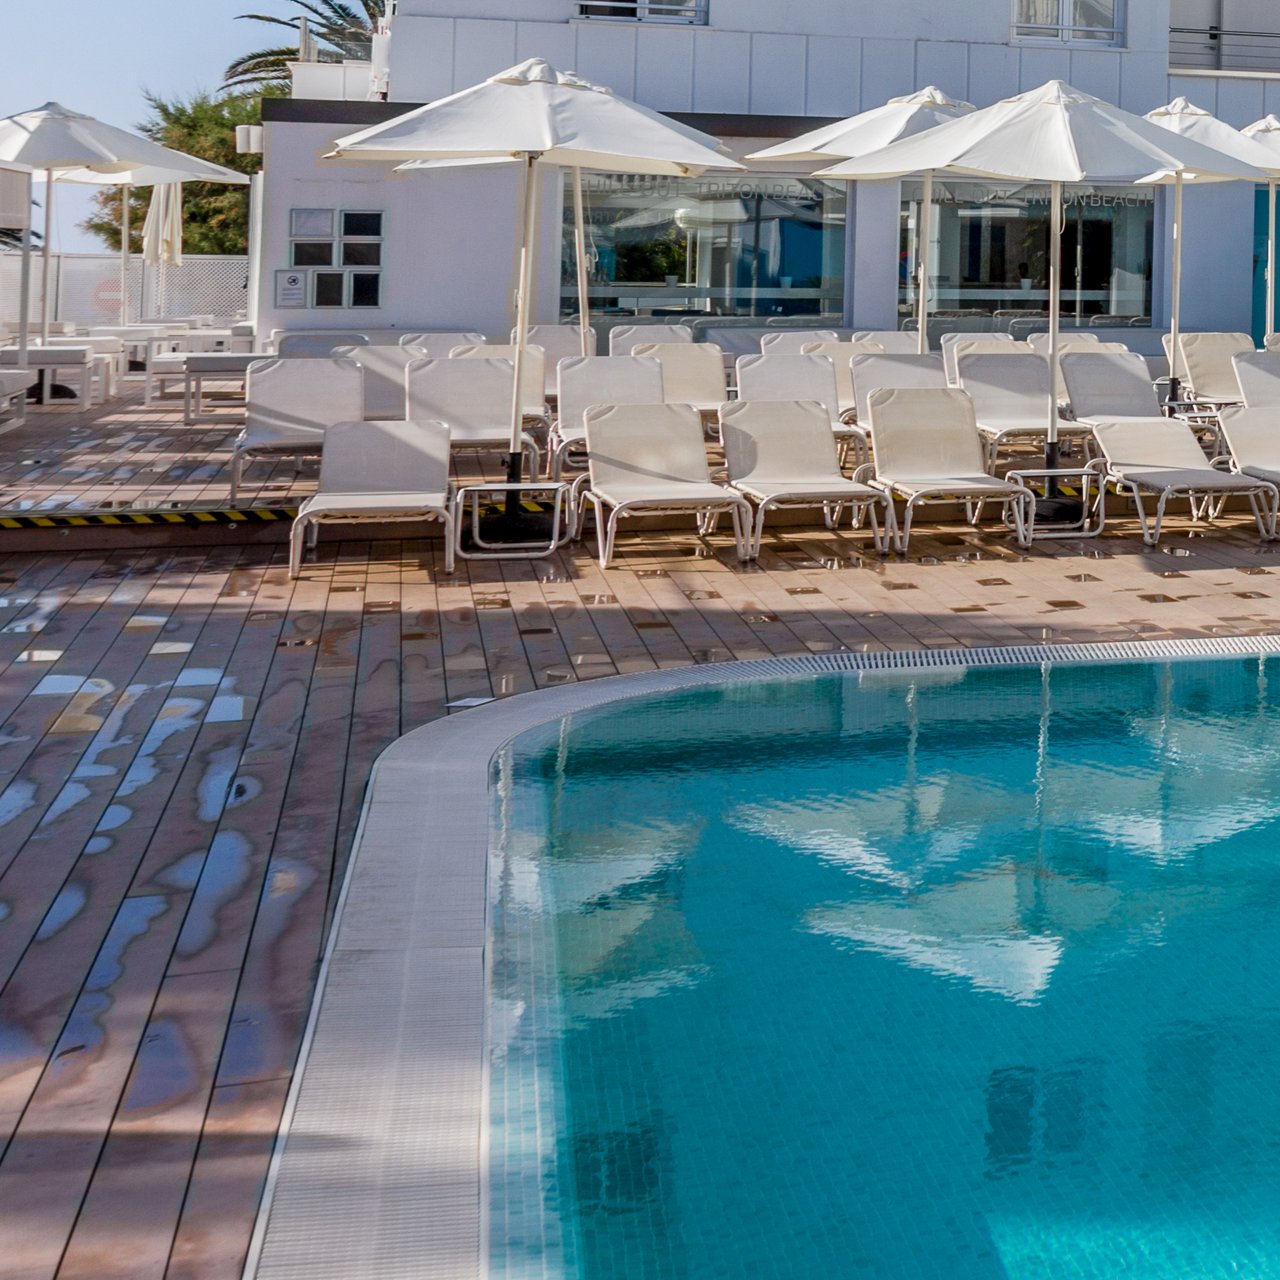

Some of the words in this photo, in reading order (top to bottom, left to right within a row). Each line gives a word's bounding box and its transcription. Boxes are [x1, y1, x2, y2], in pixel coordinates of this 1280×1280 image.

[581, 178, 633, 194] HILL
[694, 182, 768, 199] TRITON
[1019, 189, 1087, 206] TRION
[1090, 191, 1148, 207] BEACH
